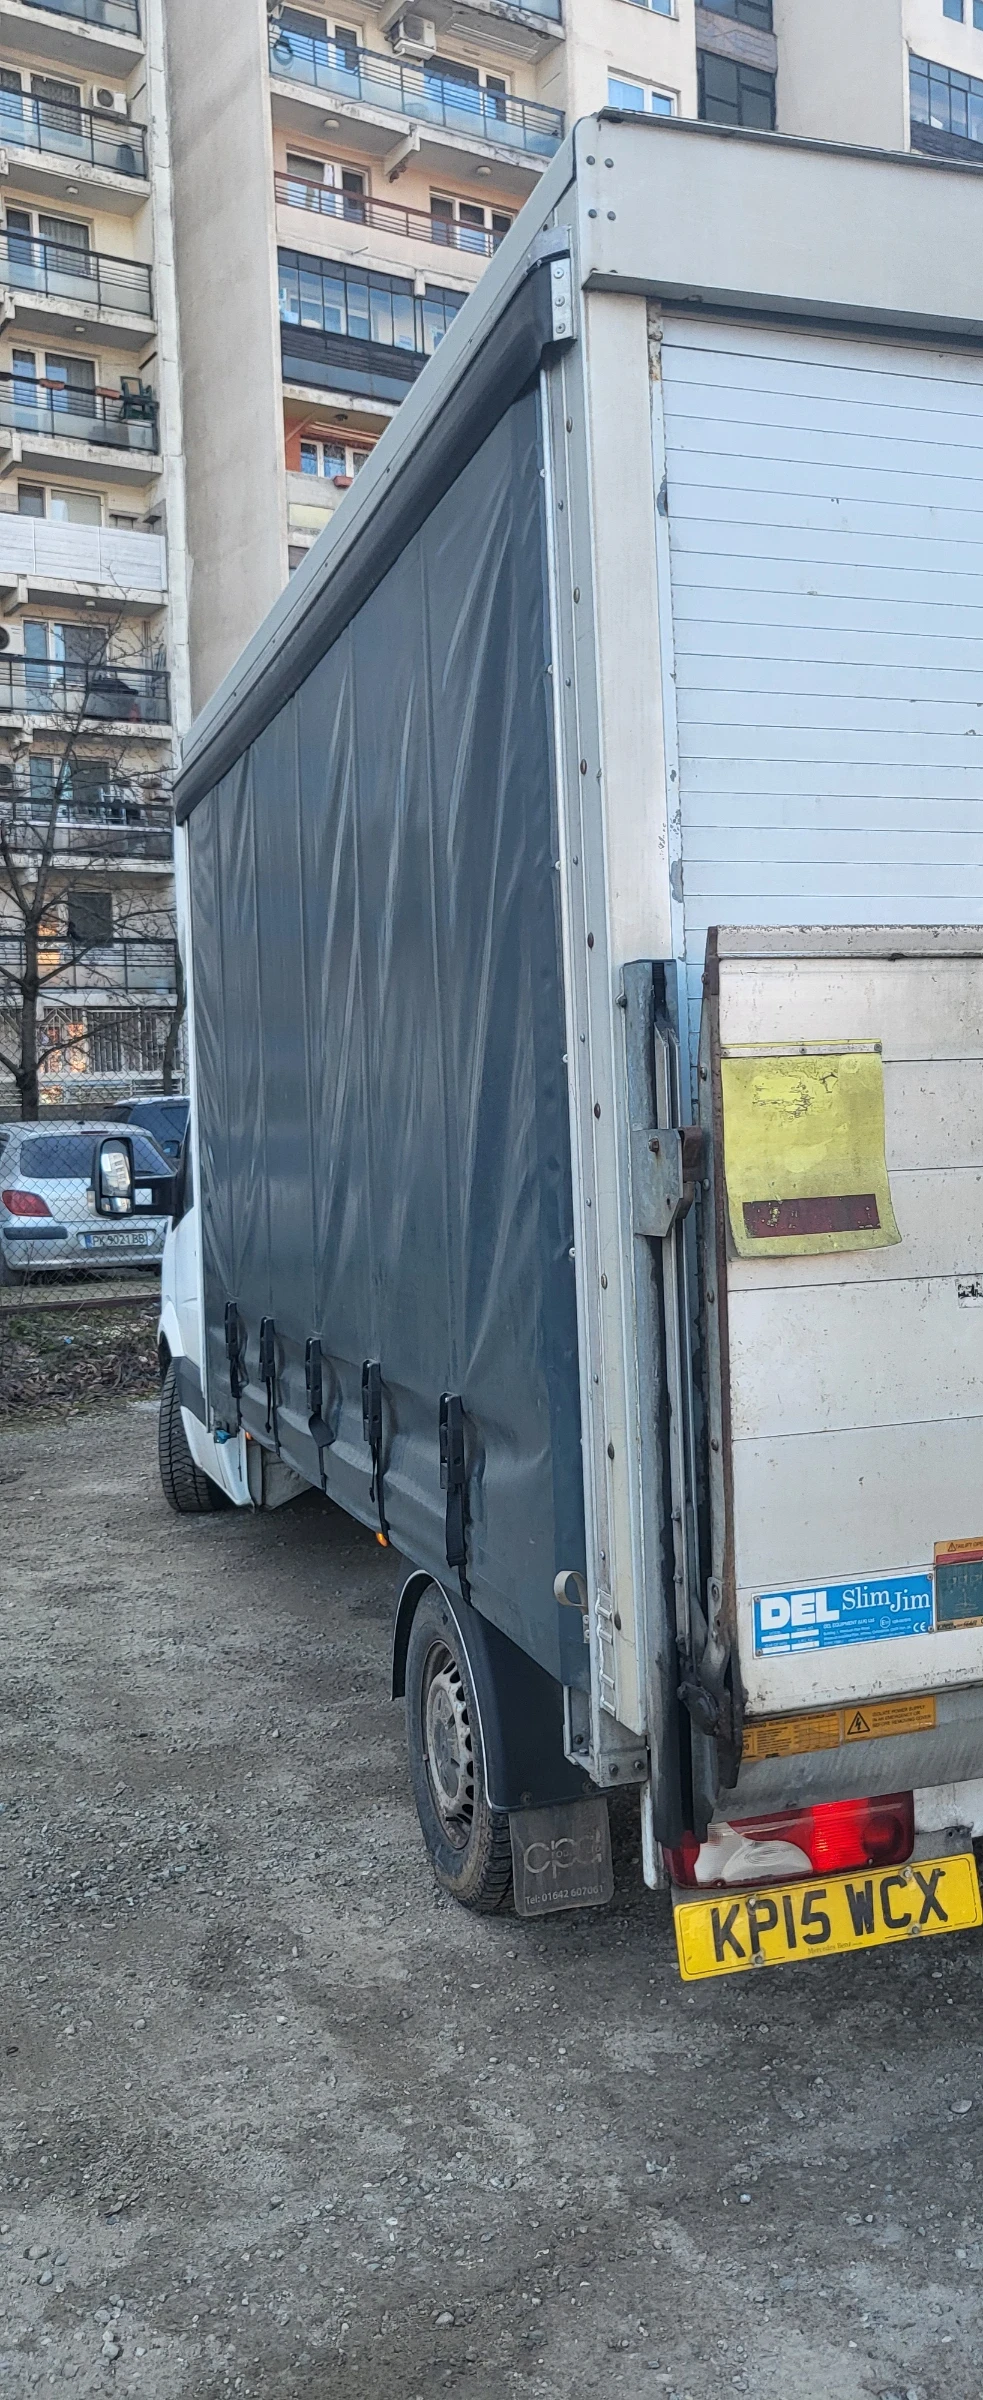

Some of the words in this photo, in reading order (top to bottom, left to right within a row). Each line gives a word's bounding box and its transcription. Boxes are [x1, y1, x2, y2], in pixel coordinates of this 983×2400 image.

[761, 1591, 840, 1631] DEL
[842, 1586, 891, 1610] Slim
[890, 1589, 931, 1612] Jim
[525, 1894, 541, 1905] Tel:
[542, 1889, 569, 1902] 01642
[570, 1885, 603, 1897] 607061
[710, 1889, 831, 1962] KP15
[845, 1868, 948, 1936] WCX
